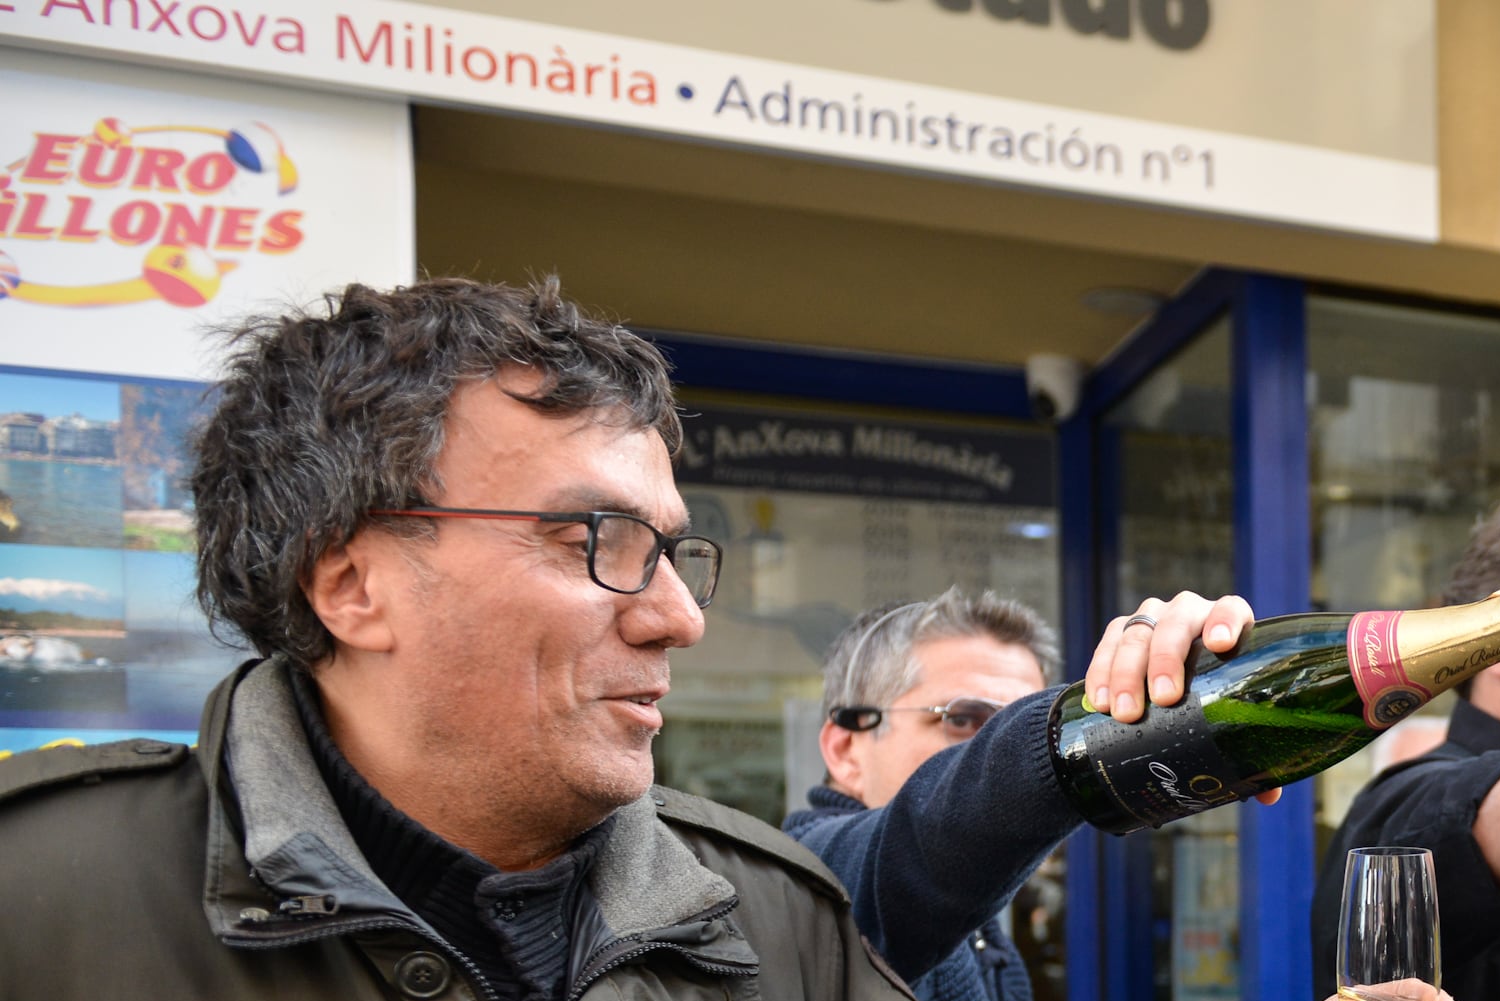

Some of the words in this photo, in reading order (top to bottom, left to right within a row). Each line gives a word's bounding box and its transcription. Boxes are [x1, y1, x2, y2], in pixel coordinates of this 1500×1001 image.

[335, 13, 657, 106] Milionària
[714, 75, 1122, 177] Administración
[20, 132, 237, 195] EURO
